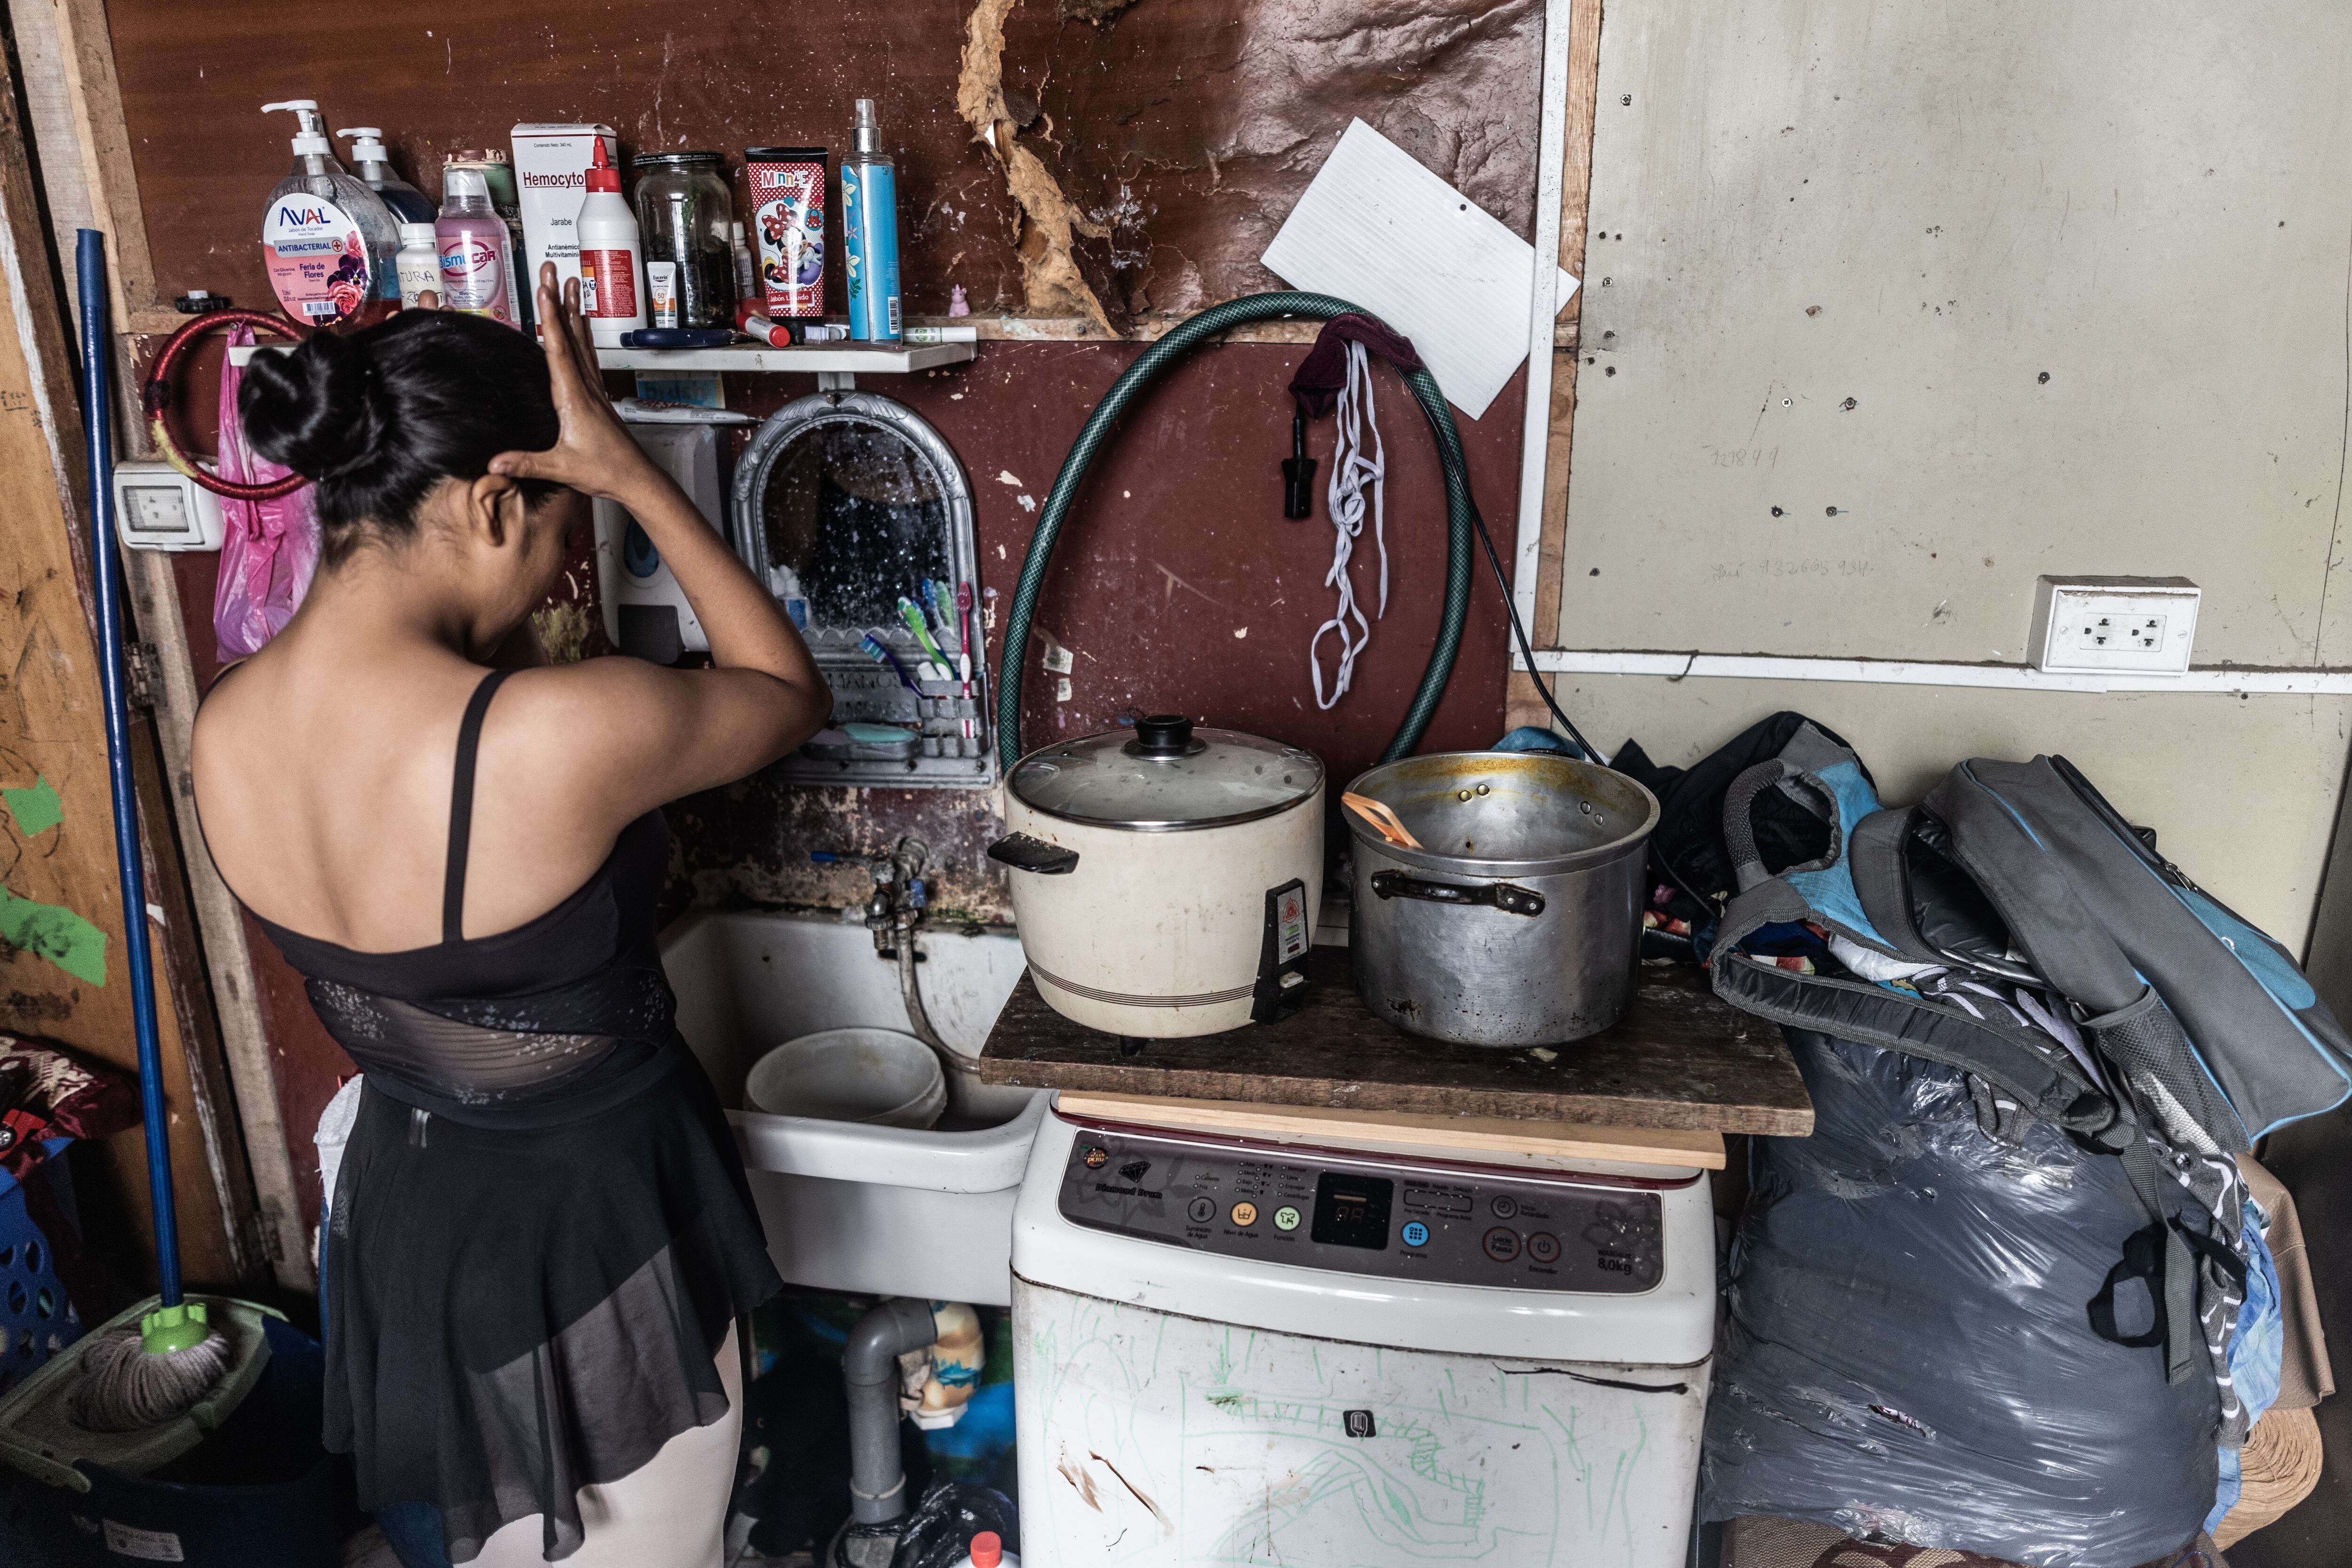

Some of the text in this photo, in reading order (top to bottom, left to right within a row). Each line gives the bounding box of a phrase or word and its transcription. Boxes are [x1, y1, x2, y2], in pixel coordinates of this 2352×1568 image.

[279, 207, 331, 227] AVAL
[278, 242, 332, 253] ANTIBACTERIAL
[398, 270, 435, 283] TURA
[1095, 1183, 1163, 1200] Diamond Drum
[1185, 1225, 1212, 1234] Suministro
[1273, 1234, 1295, 1242] Función
[1493, 1235, 1513, 1244] Inicio
[1491, 1244, 1513, 1253] Pausa
[1529, 1265, 1558, 1274] Encender
[1597, 1258, 1632, 1275] 8,0kg
